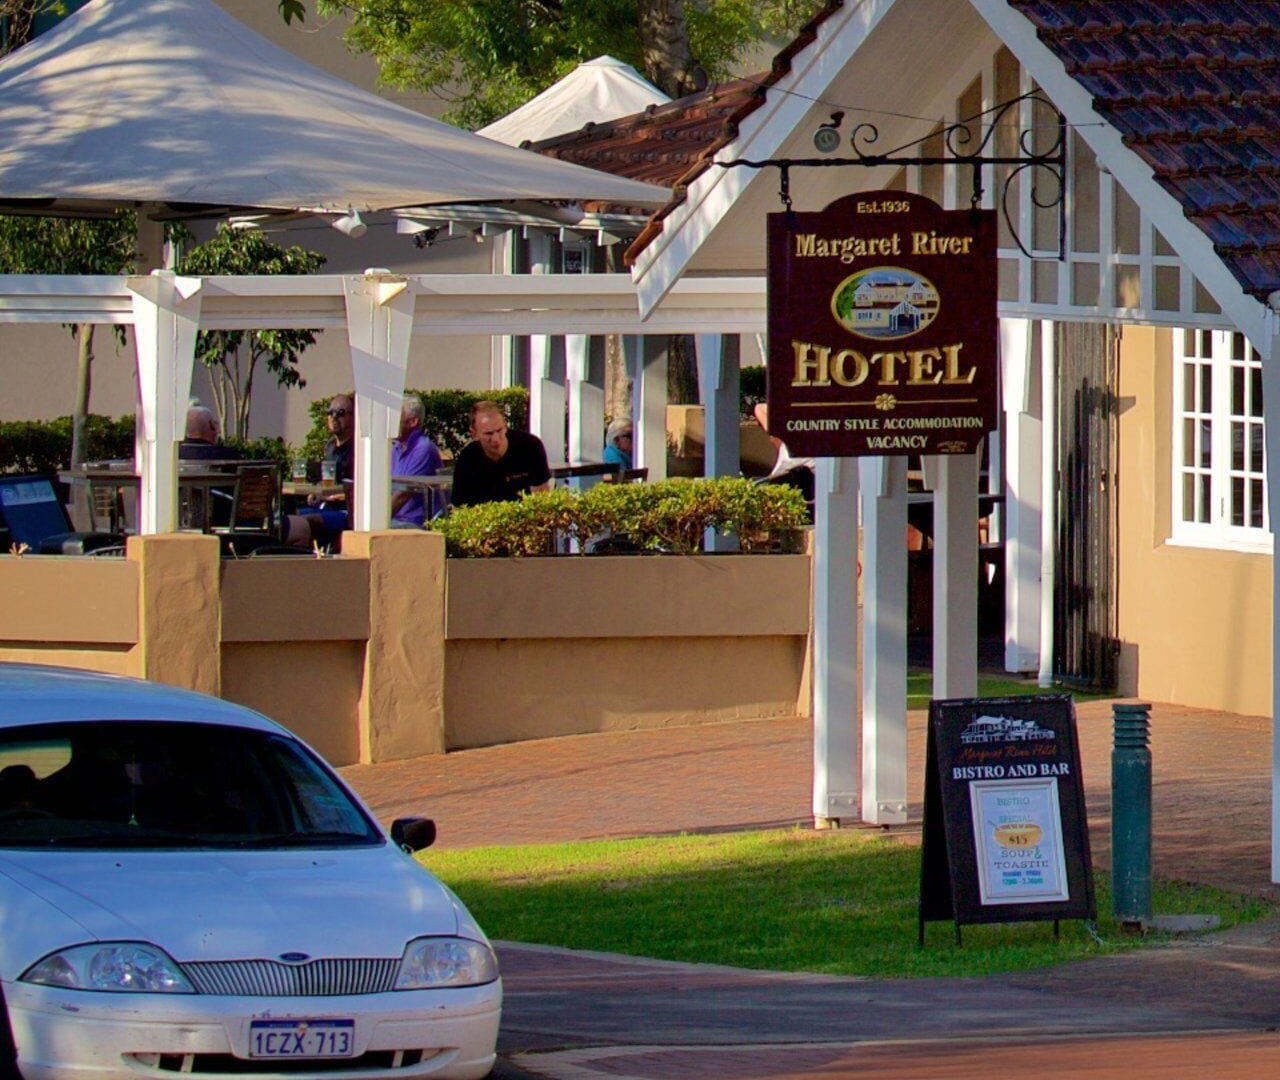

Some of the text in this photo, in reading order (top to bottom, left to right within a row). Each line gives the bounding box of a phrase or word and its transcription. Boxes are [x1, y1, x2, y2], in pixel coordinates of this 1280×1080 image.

[795, 231, 973, 264] Margaret River
[790, 339, 977, 387] HOTEL
[786, 417, 984, 432] COUNTRY STYLE ACCOMMODATION
[866, 435, 928, 449] VACANCY
[953, 763, 1070, 779] BISTRO AND BAR
[1001, 849, 1034, 858] SOUP
[993, 860, 1049, 869] TOASTIE
